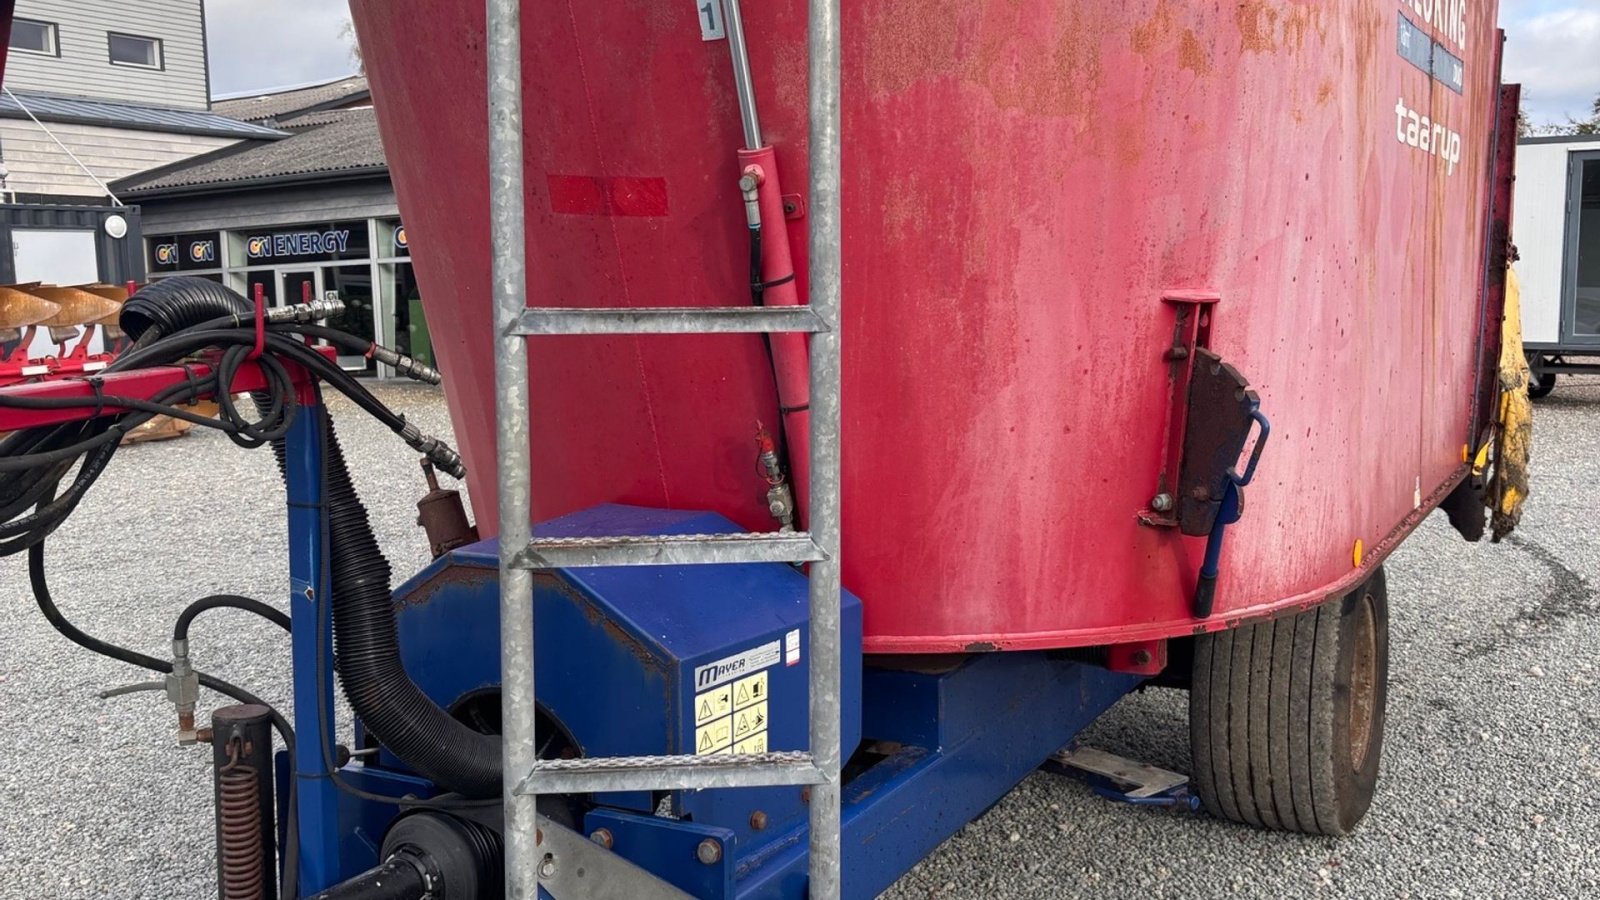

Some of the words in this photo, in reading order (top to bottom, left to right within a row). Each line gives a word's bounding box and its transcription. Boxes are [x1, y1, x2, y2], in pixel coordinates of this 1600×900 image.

[701, 2, 715, 30] 1
[1401, 0, 1466, 51] OKING
[1395, 97, 1461, 176] taarup
[273, 230, 349, 257] ENERGY
[698, 658, 746, 687] MAYER
